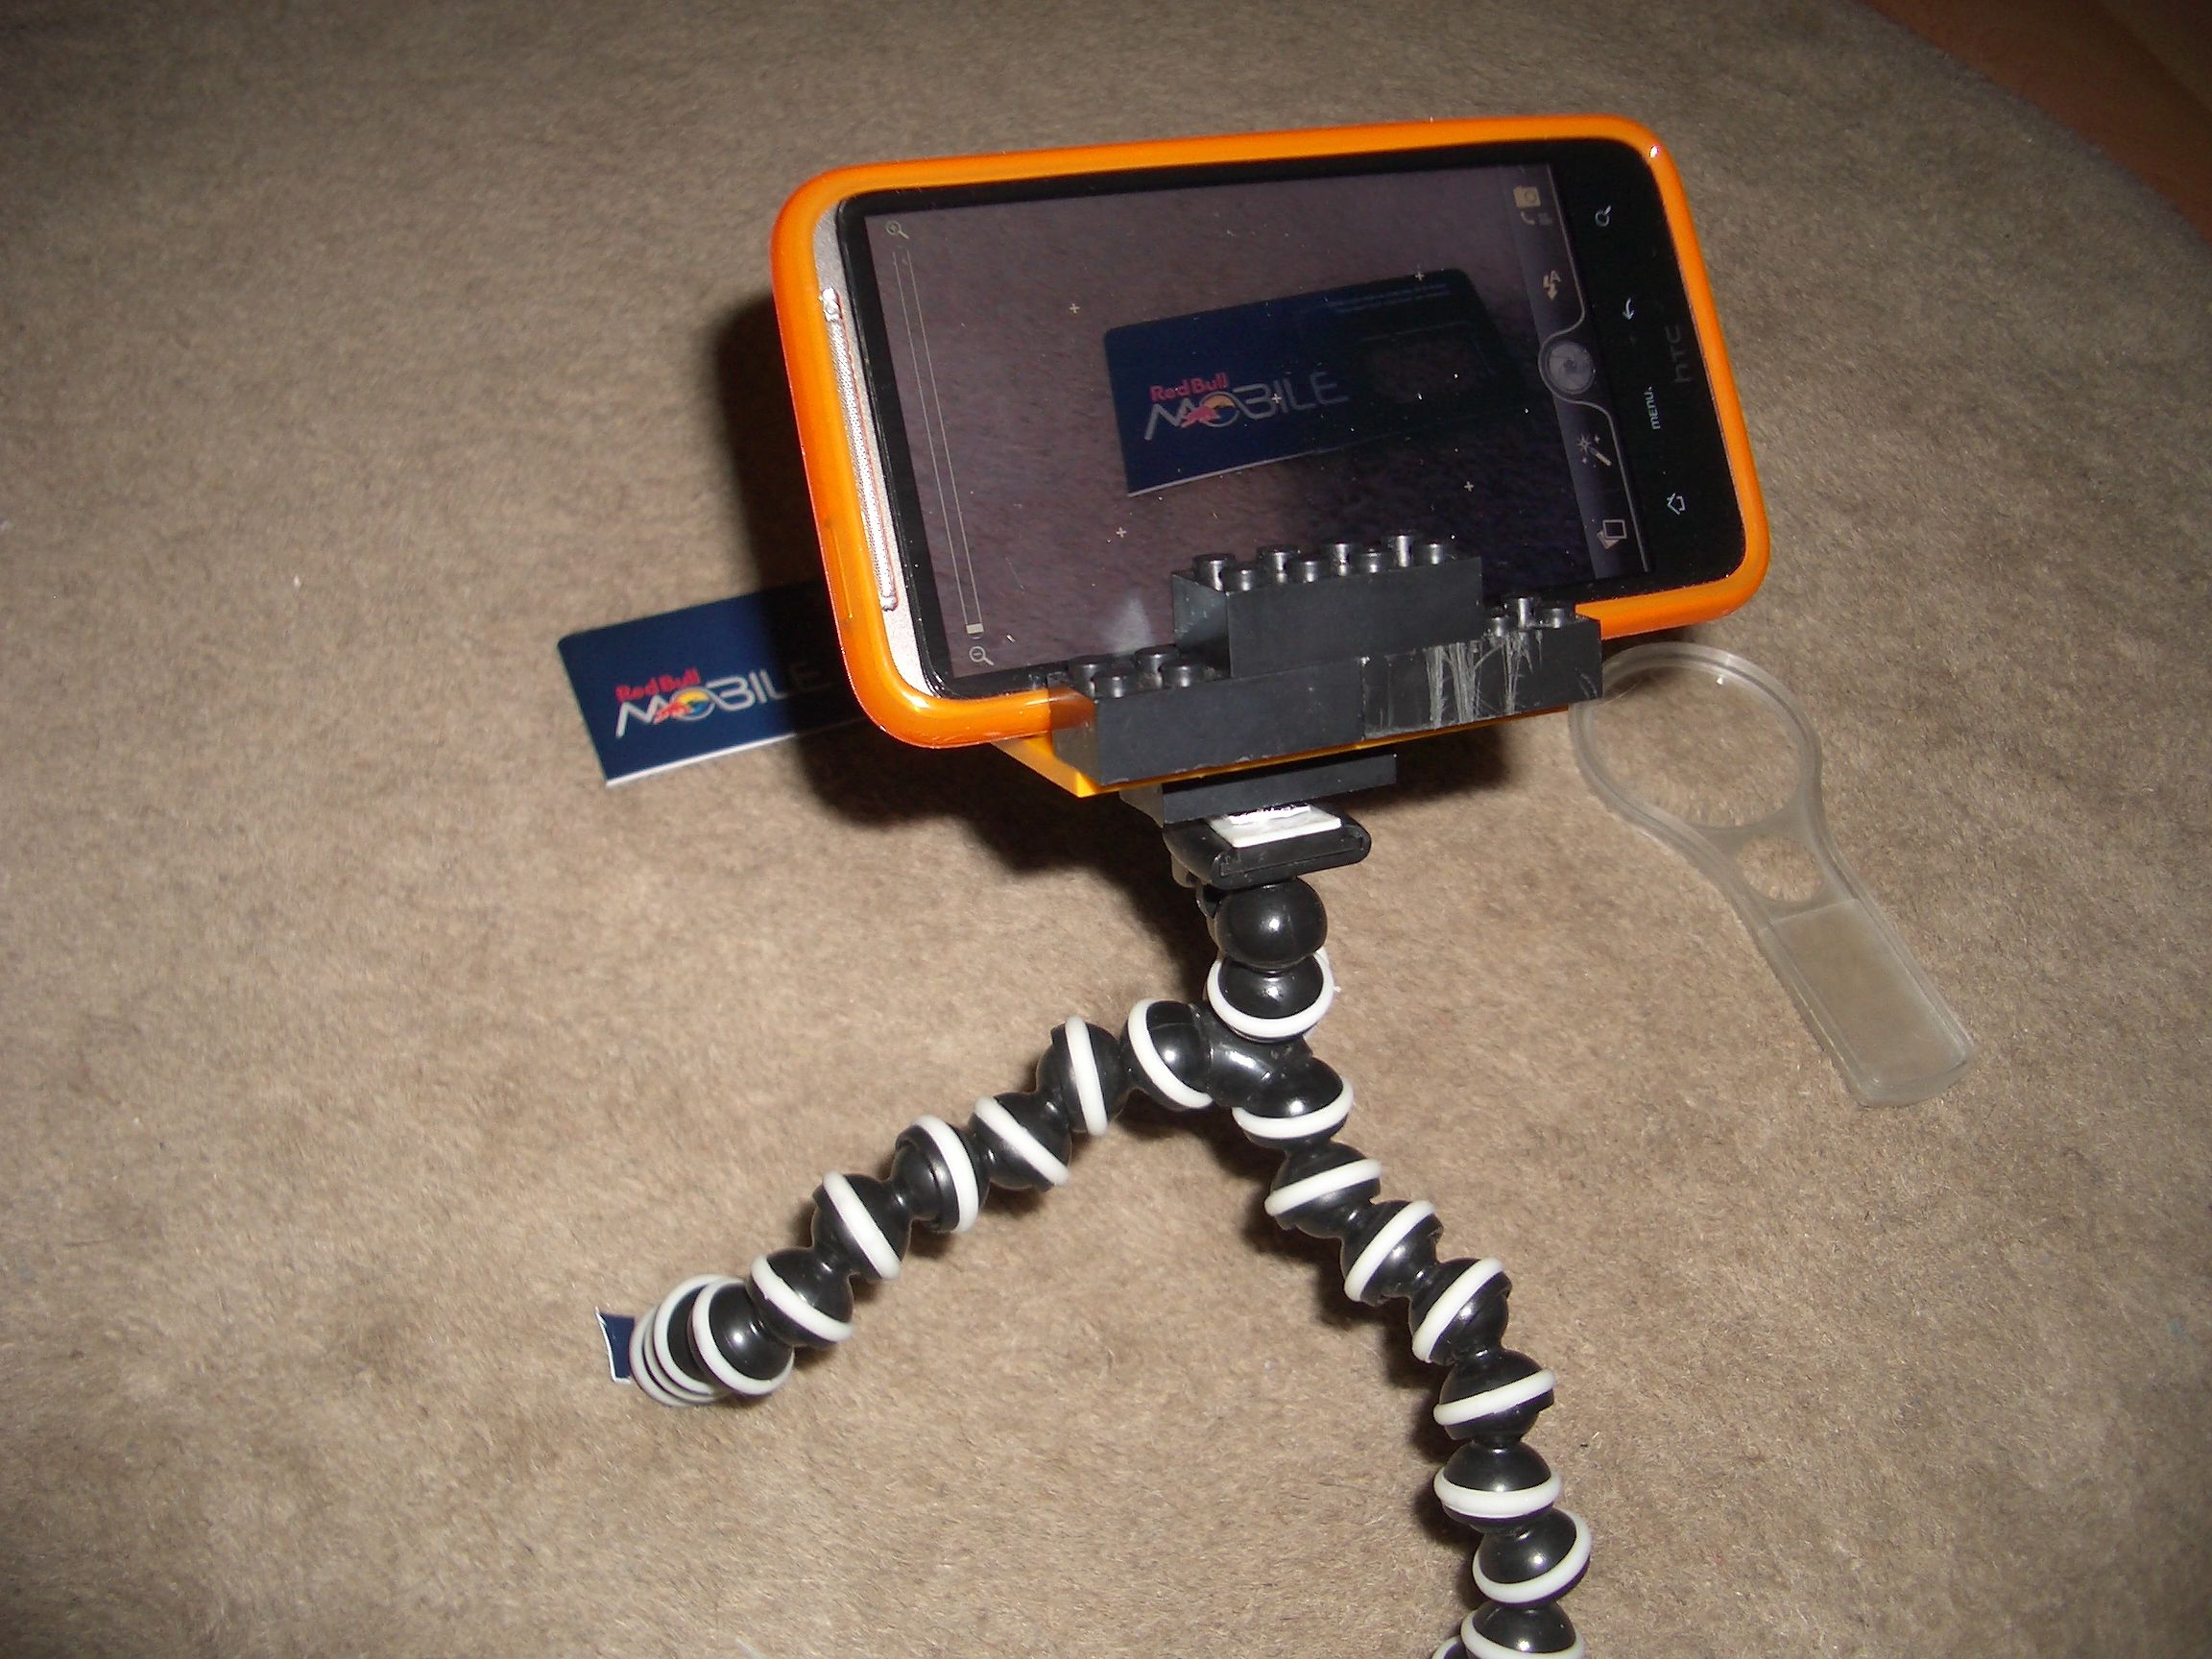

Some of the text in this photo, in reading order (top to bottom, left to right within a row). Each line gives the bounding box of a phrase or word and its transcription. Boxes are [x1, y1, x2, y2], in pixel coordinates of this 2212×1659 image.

[1150, 372, 1229, 401] Red Bull
[1144, 371, 1349, 441] MOBILE
[1644, 391, 1661, 429] menu
[615, 667, 701, 702] Red Bull
